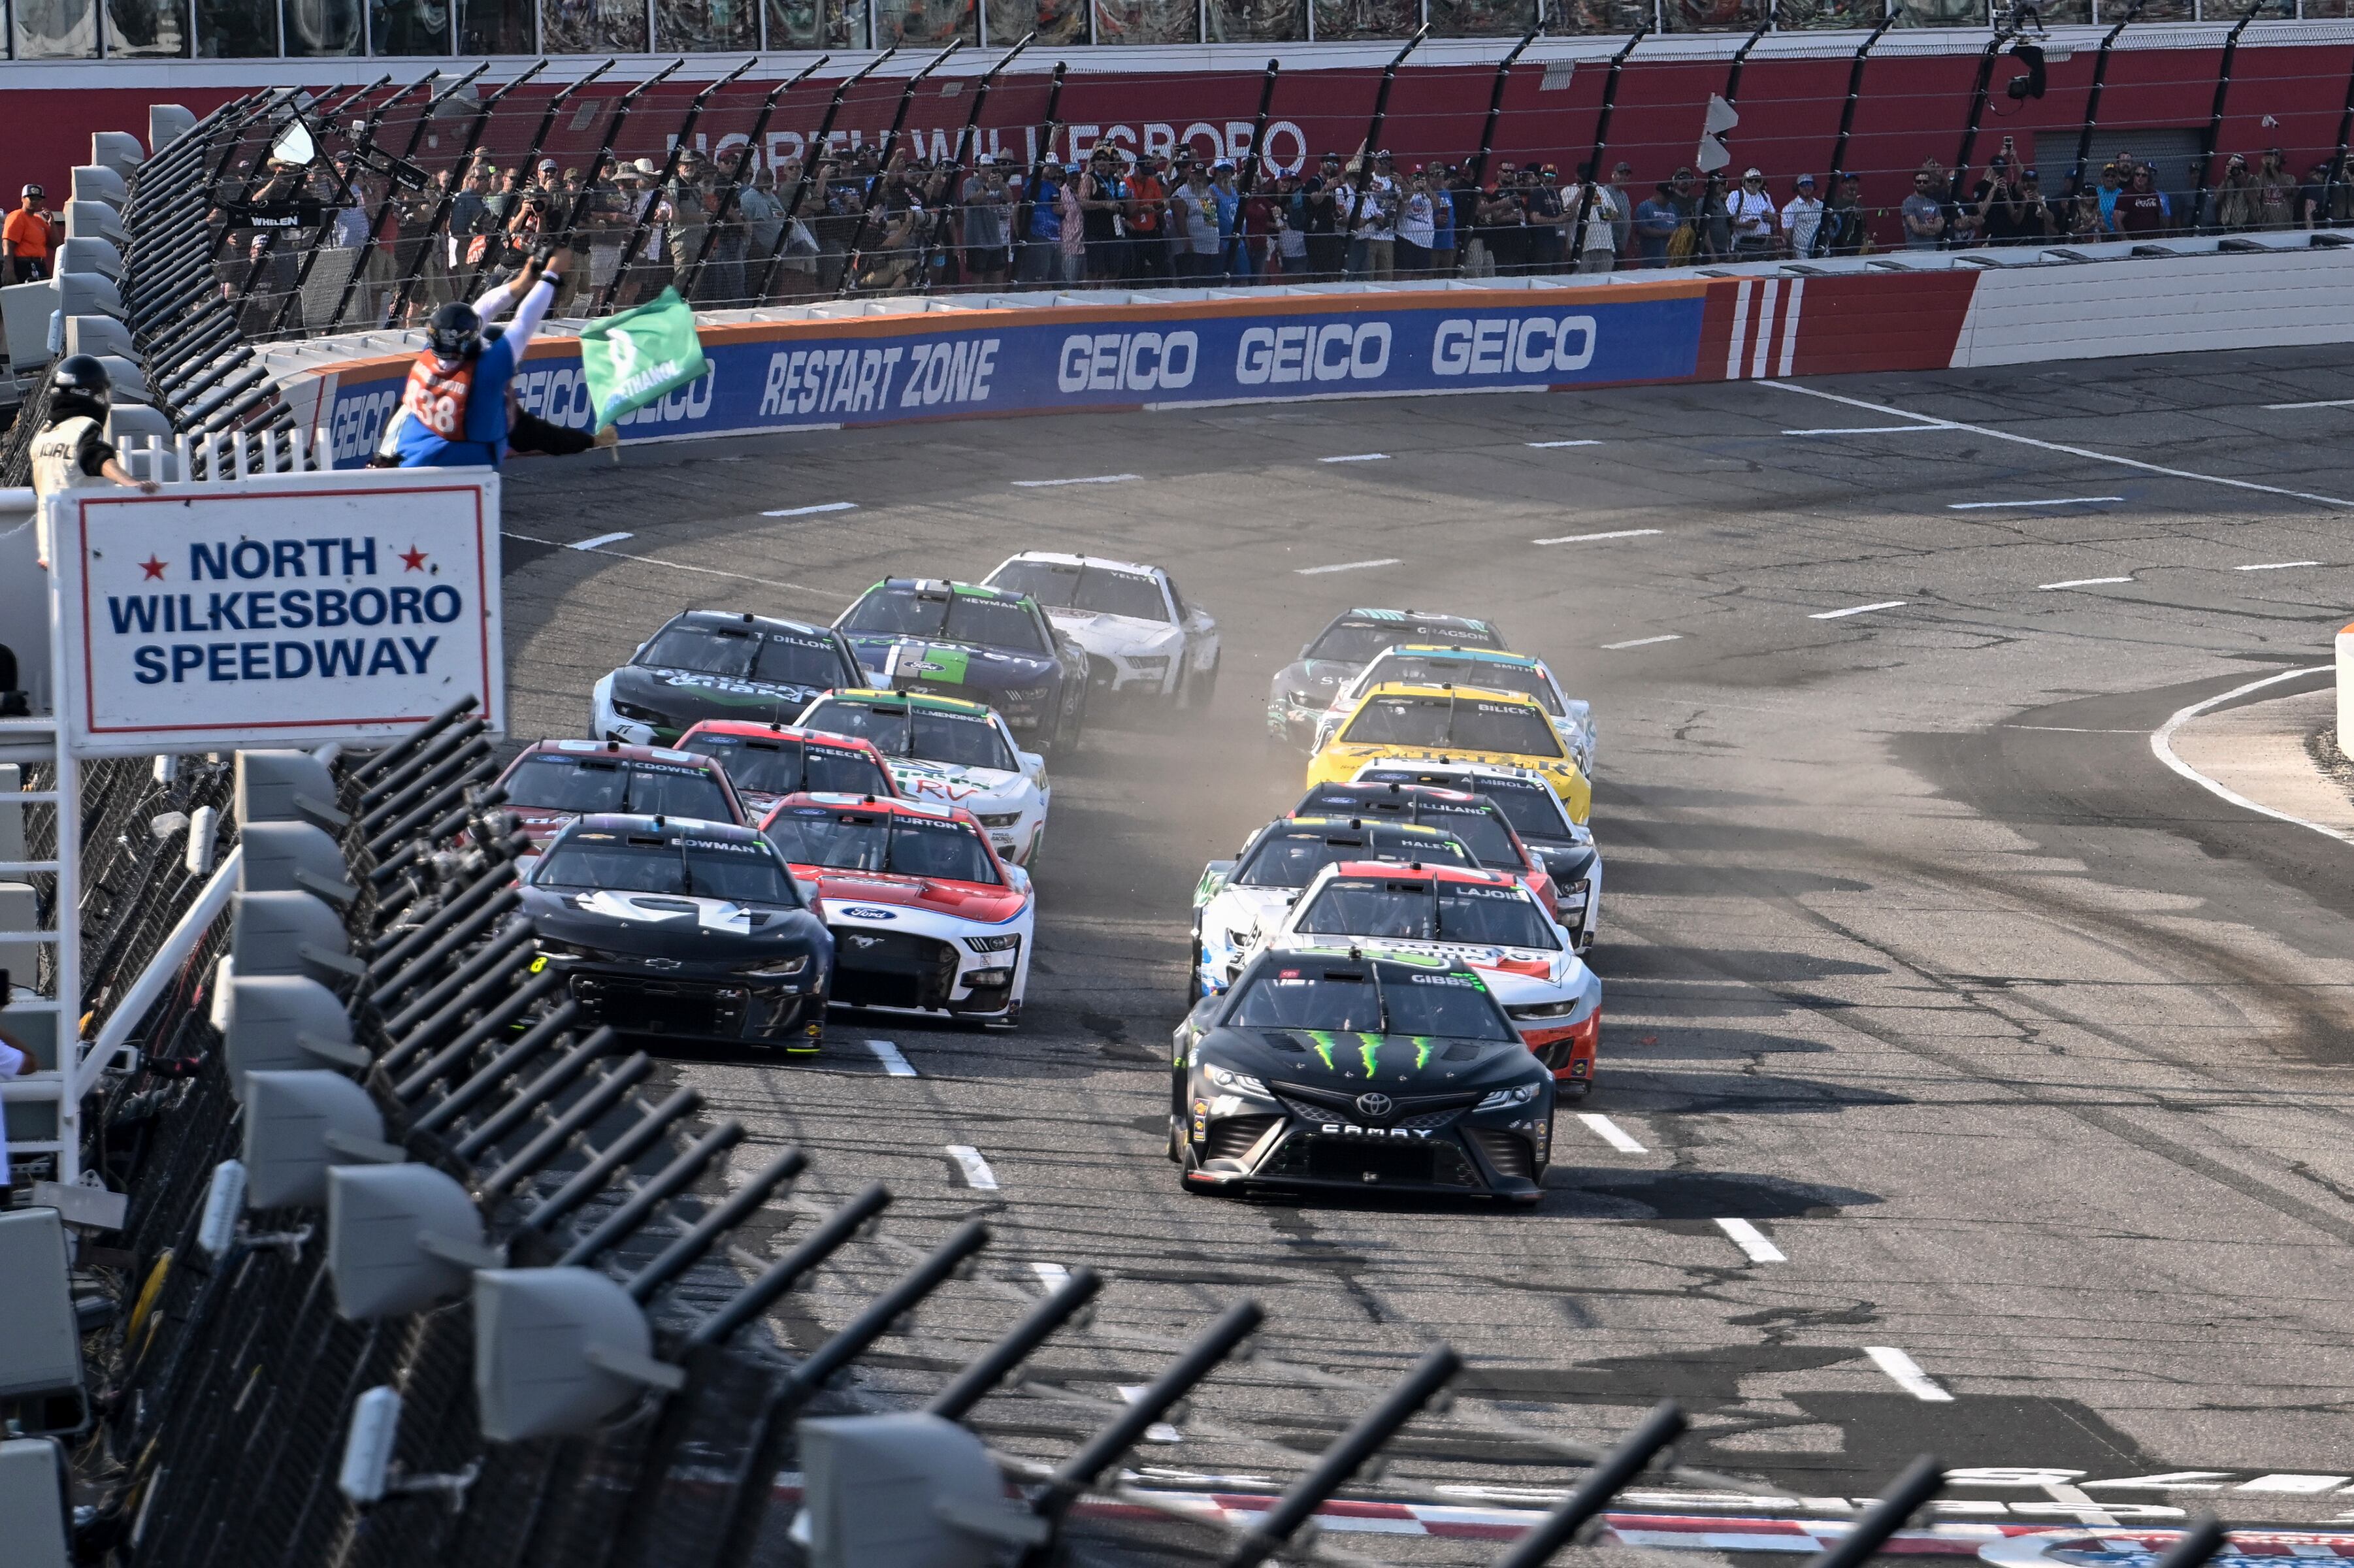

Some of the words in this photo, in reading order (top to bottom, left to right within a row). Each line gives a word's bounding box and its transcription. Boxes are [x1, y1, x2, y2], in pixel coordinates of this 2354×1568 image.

[252, 216, 298, 226] WHELEN
[1058, 330, 1198, 393] GEICO
[1236, 321, 1392, 384] GEICO
[1432, 315, 1596, 374] GEICO
[759, 348, 906, 416] RESTART
[900, 338, 1000, 406] ZONE
[331, 390, 396, 462] GEICO
[189, 536, 377, 581] NORTH
[1111, 572, 1148, 581] YELEY
[107, 584, 462, 634] WILKESBORO
[962, 596, 1019, 610] NEWMAN
[1417, 627, 1489, 641] GRAGSON
[774, 634, 833, 650] DILLON
[133, 636, 440, 685] SPEEDWAY
[1493, 662, 1534, 673] SMITH
[1479, 703, 1534, 717] BILICK
[617, 725, 633, 734] 77
[805, 745, 863, 760] PREECE
[916, 779, 979, 801] RV
[893, 815, 958, 830] BURTON
[672, 838, 755, 854] BOWMAN
[1401, 840, 1453, 851] HALEY
[1457, 887, 1523, 900] LAJOIE
[851, 906, 887, 919] Ford
[1411, 974, 1474, 988] GIBBS
[1322, 1124, 1433, 1140] CAMRY
